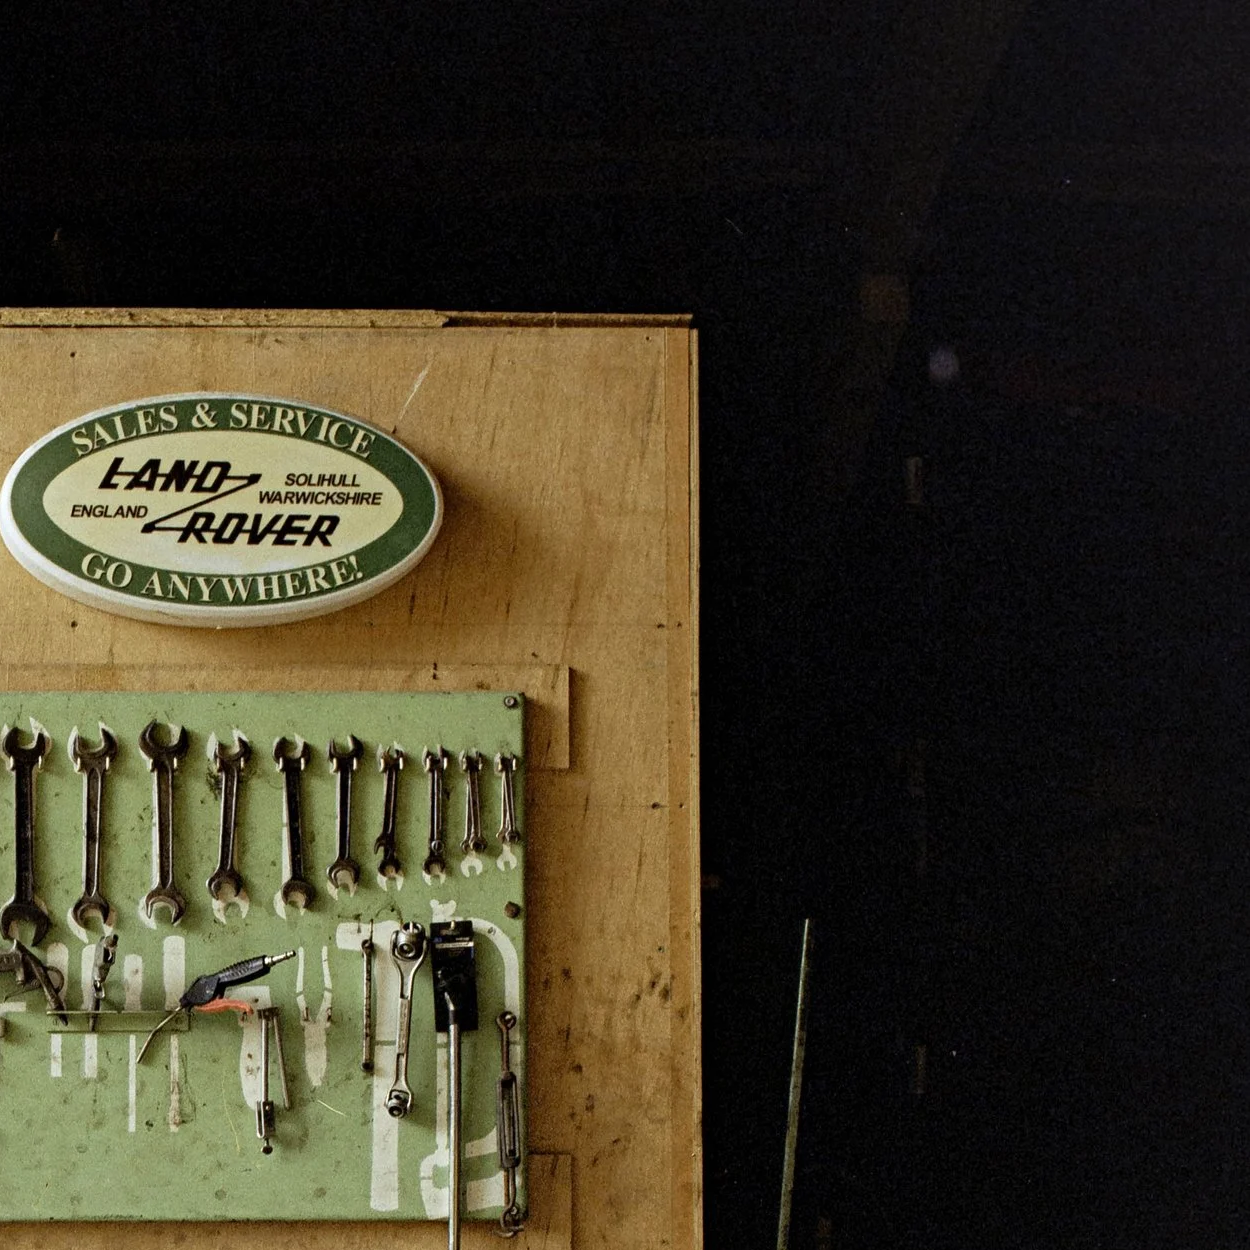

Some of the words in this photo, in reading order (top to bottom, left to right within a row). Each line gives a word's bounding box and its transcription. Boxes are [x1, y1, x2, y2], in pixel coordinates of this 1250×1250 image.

[71, 402, 179, 457] SALES
[190, 402, 218, 429] &
[229, 402, 377, 460] SERVICE
[98, 457, 232, 493] LAND
[284, 472, 361, 488] SOLIHULL
[70, 504, 148, 519] ENGLAND
[258, 490, 383, 506] WARWICKSHIRE
[177, 512, 340, 547] ROVER
[80, 552, 133, 590] GO
[141, 554, 364, 603] ANYWHERE!
